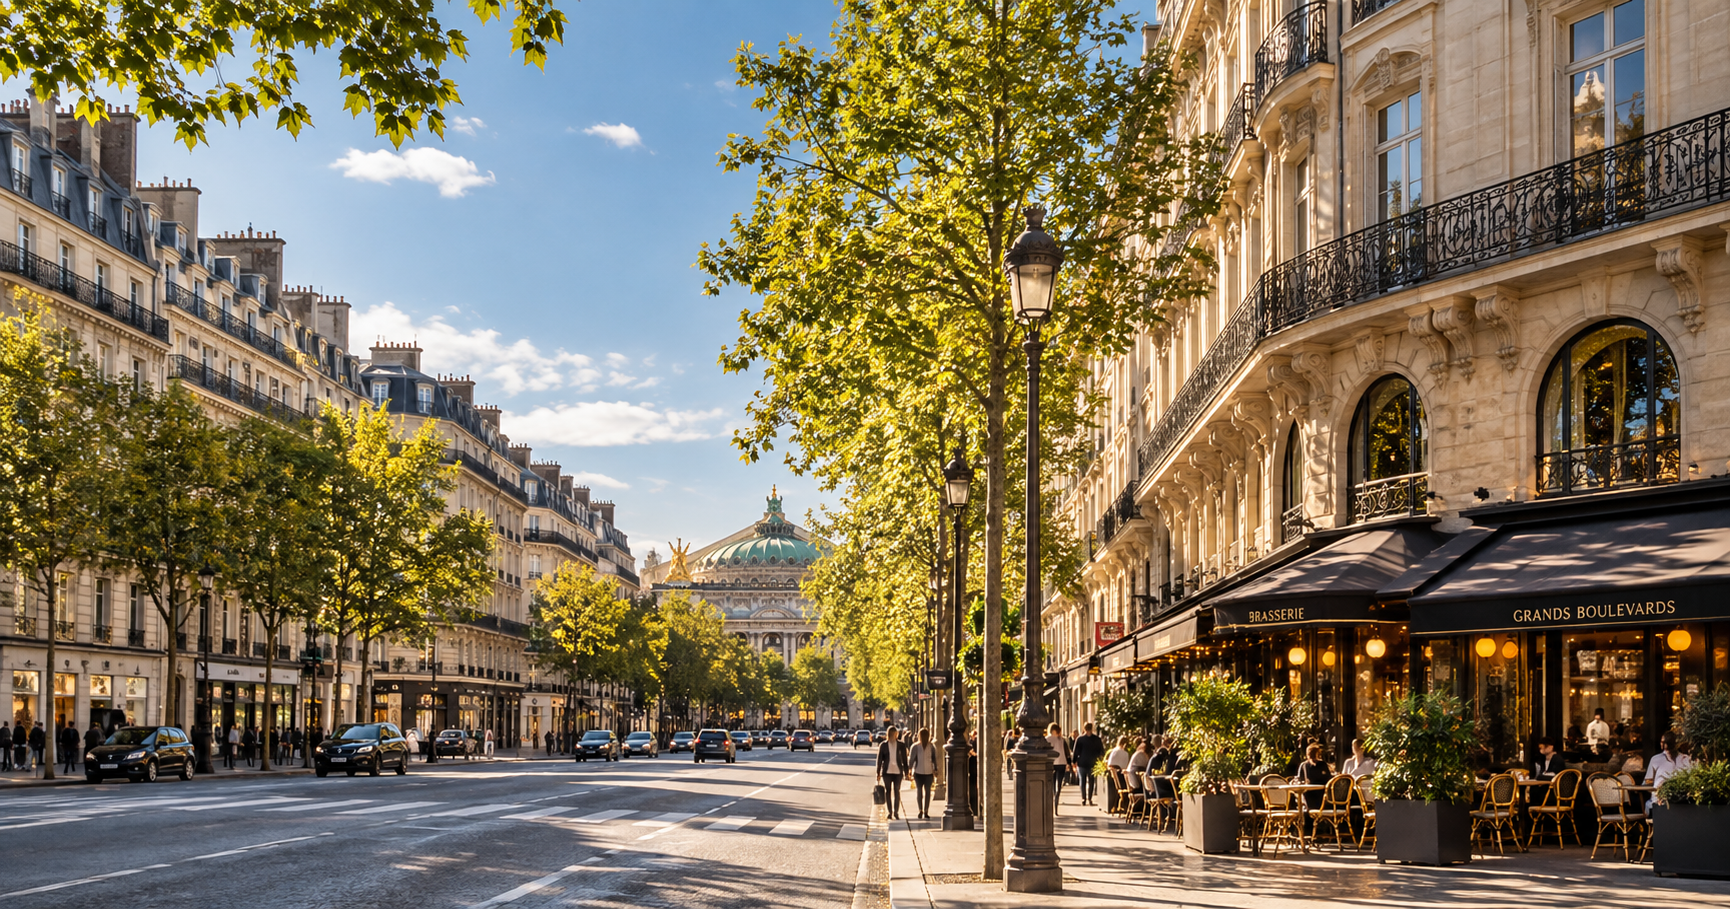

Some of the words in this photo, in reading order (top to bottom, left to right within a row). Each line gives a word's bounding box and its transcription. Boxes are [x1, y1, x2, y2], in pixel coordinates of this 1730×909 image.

[1249, 607, 1304, 623] BRASSERIE
[1513, 607, 1571, 623] GRANDS
[1577, 600, 1676, 619] BOULEVARDS
